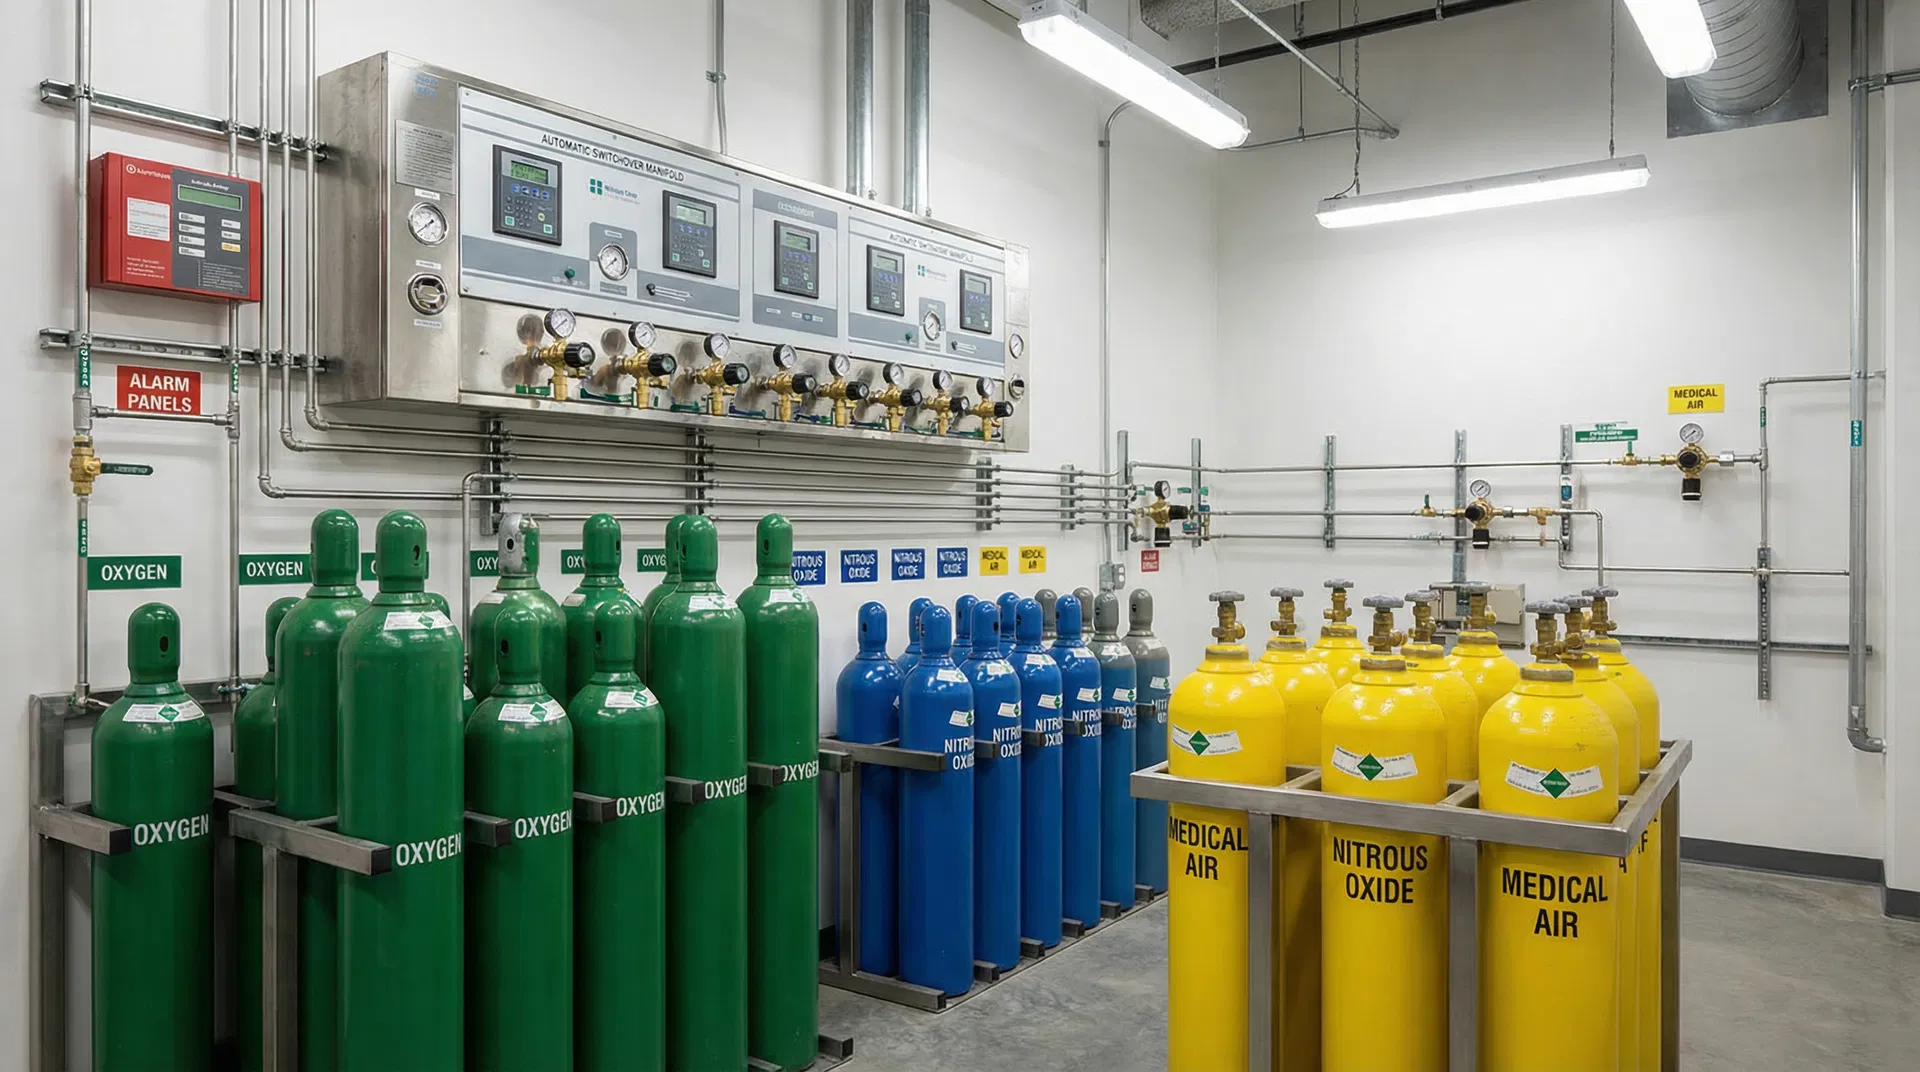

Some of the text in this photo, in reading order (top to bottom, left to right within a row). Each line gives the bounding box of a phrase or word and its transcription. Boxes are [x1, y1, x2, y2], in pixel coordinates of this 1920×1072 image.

[541, 134, 591, 156] AUTOMATIC
[646, 163, 684, 182] MANIFOLD
[129, 373, 190, 392] ALARM
[1673, 388, 1719, 398] MEDICAL
[127, 395, 192, 413] PANELS
[1687, 400, 1704, 410] AIR
[101, 564, 167, 581] OXYGEN
[246, 561, 303, 577] OXYGEN
[477, 557, 498, 571] OXY
[642, 554, 667, 567] OXYG
[843, 553, 876, 566] NITROUS
[134, 813, 209, 846] OXYGEN
[514, 809, 572, 839] OXYGEN
[1169, 816, 1248, 851] MEDICAL
[396, 832, 462, 867] OXYGEN
[1333, 836, 1428, 871] NITROUS
[1185, 852, 1218, 880] AIR
[1346, 872, 1414, 903] OXIDE
[1502, 867, 1608, 904] MEDICAL
[1534, 908, 1579, 938] AIR
